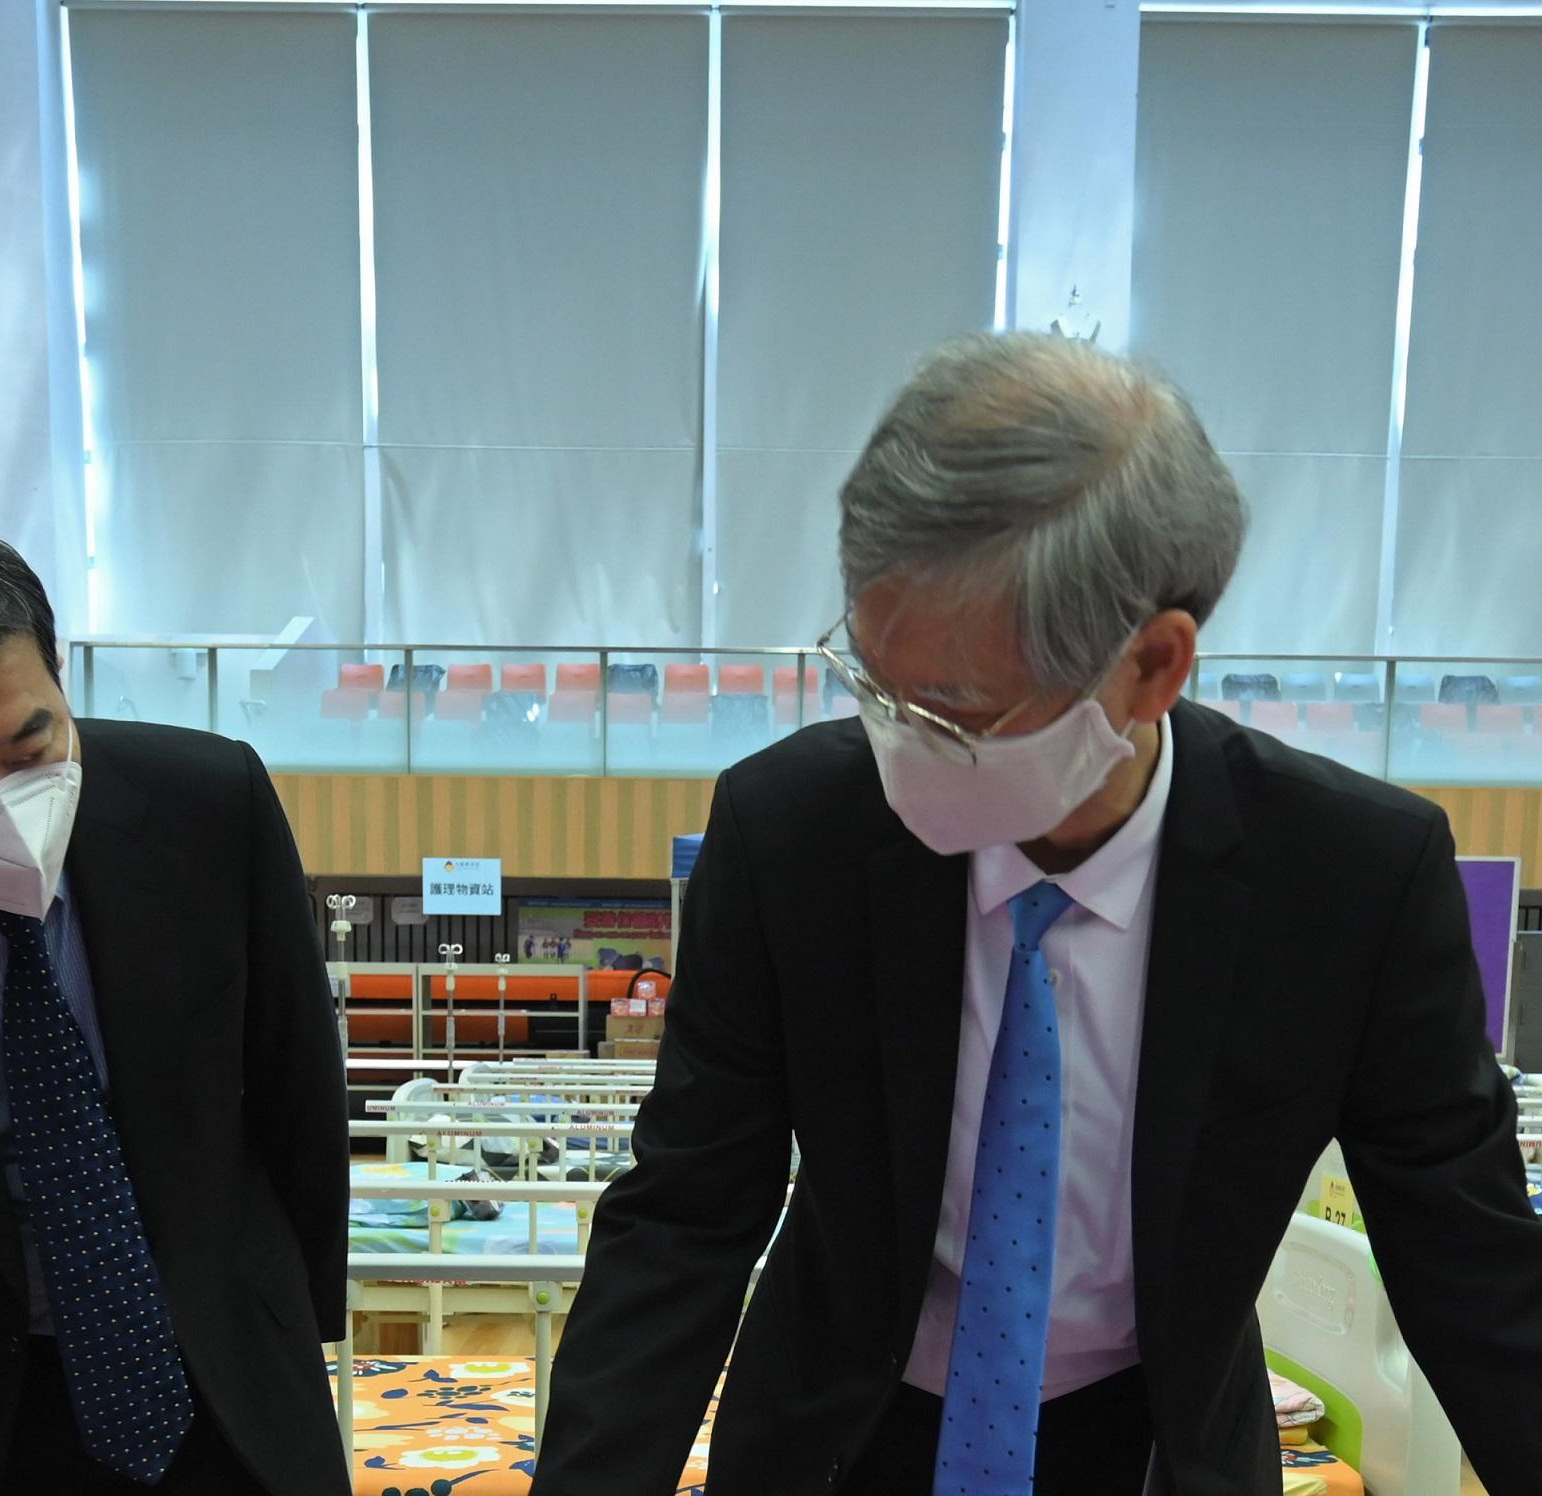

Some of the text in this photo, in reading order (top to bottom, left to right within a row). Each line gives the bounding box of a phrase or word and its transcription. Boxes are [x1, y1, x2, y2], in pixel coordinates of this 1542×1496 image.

[429, 882, 494, 896] 護理物資站
